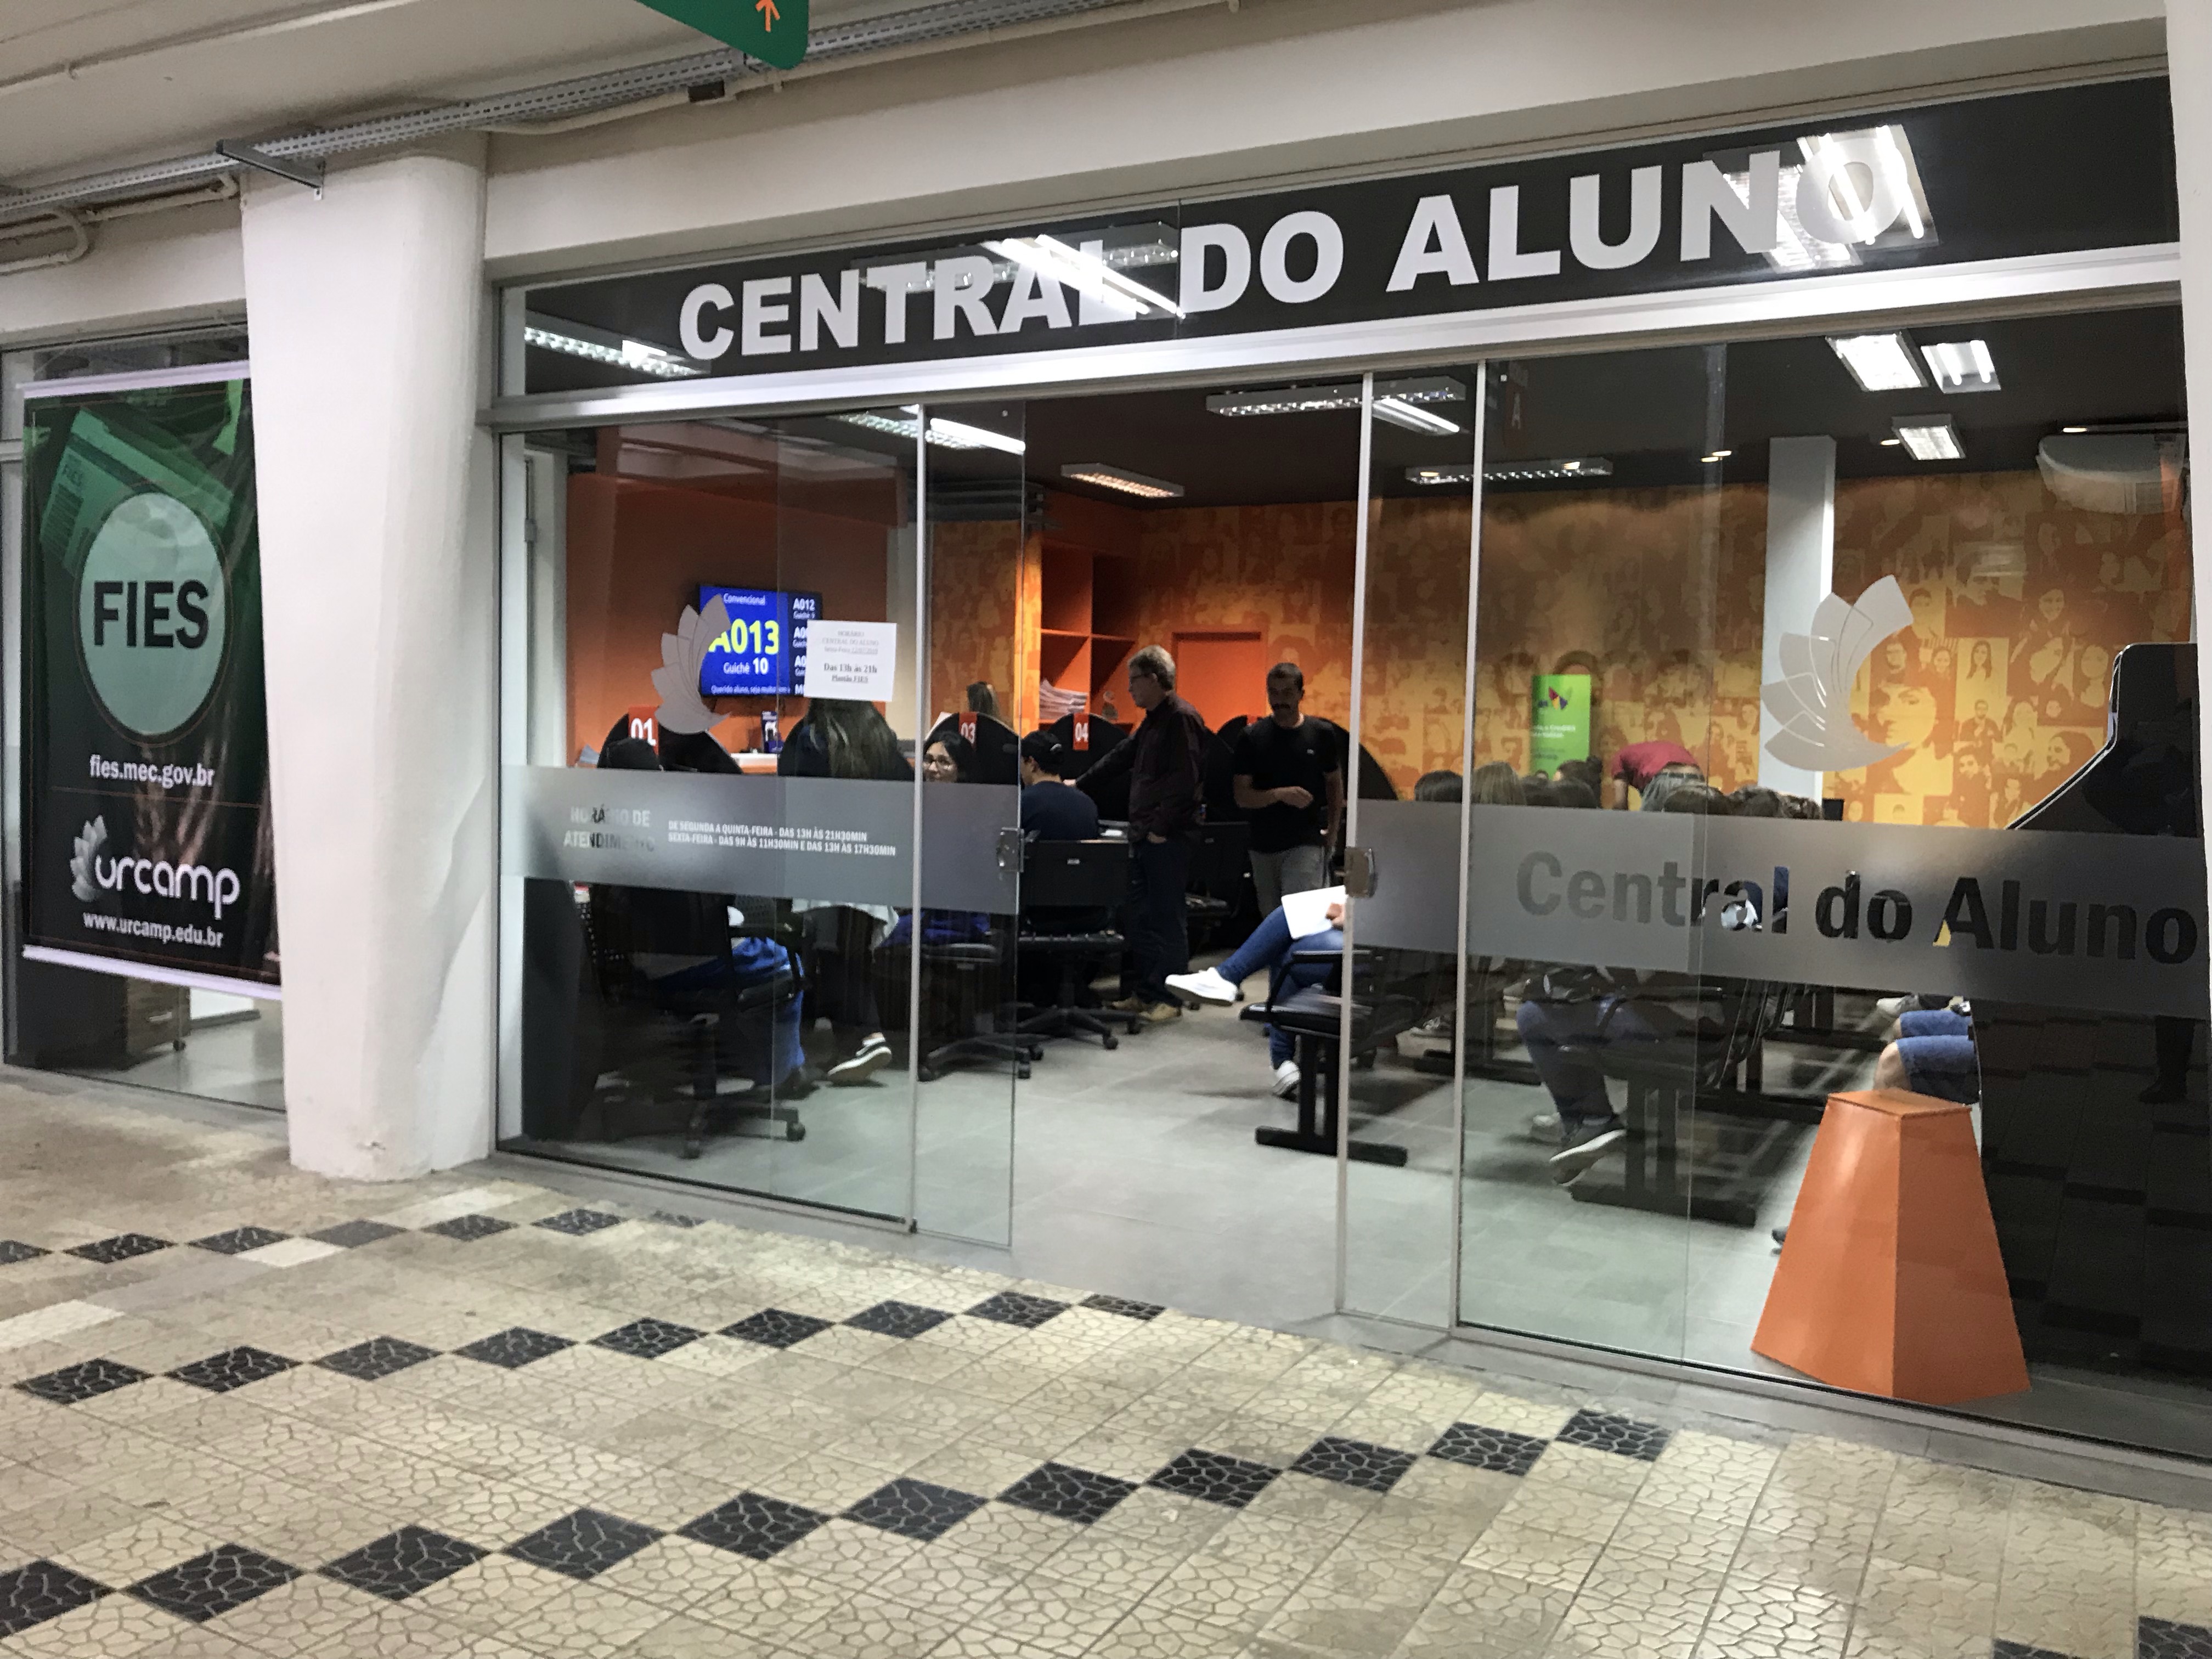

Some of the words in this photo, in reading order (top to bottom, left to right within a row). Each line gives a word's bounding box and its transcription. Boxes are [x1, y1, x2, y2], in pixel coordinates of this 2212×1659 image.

[679, 240, 1147, 360] CENTRAL
[1179, 211, 1344, 314] DO
[1385, 137, 1905, 293] ALUNO
[723, 593, 766, 606] Convencional
[793, 598, 815, 611] A012
[92, 579, 210, 650] FIES
[723, 662, 750, 675] Guichê
[752, 657, 769, 675] 10
[823, 662, 837, 671] Das
[839, 663, 852, 672] 13h
[864, 664, 877, 673] 21h
[631, 718, 656, 746] 01
[1075, 722, 1089, 742] 04
[89, 754, 216, 789] fies.mec.gov.br
[633, 809, 651, 827] DE
[669, 820, 678, 831] DE
[680, 821, 714, 832] SEGUNDA
[715, 823, 720, 833] A
[722, 823, 773, 837] QUINTA-FEIRA
[779, 827, 794, 838] DAS
[797, 828, 811, 839] 13H
[825, 830, 867, 842] 21H30MIN
[668, 832, 713, 844] SEXTA-FEIRA
[719, 835, 733, 846] DAS
[735, 836, 746, 847] 9H
[759, 837, 798, 850] 11H30MIN
[800, 840, 805, 850] E
[807, 840, 822, 851] DAS
[825, 842, 839, 853] 13H
[854, 844, 896, 856] 17H30MIN
[94, 854, 240, 920] urcamp
[1516, 851, 1790, 934] Central
[1815, 870, 1913, 942] do
[1932, 876, 2198, 966] Aluno
[83, 912, 224, 948] www.urcamp.edu.br
